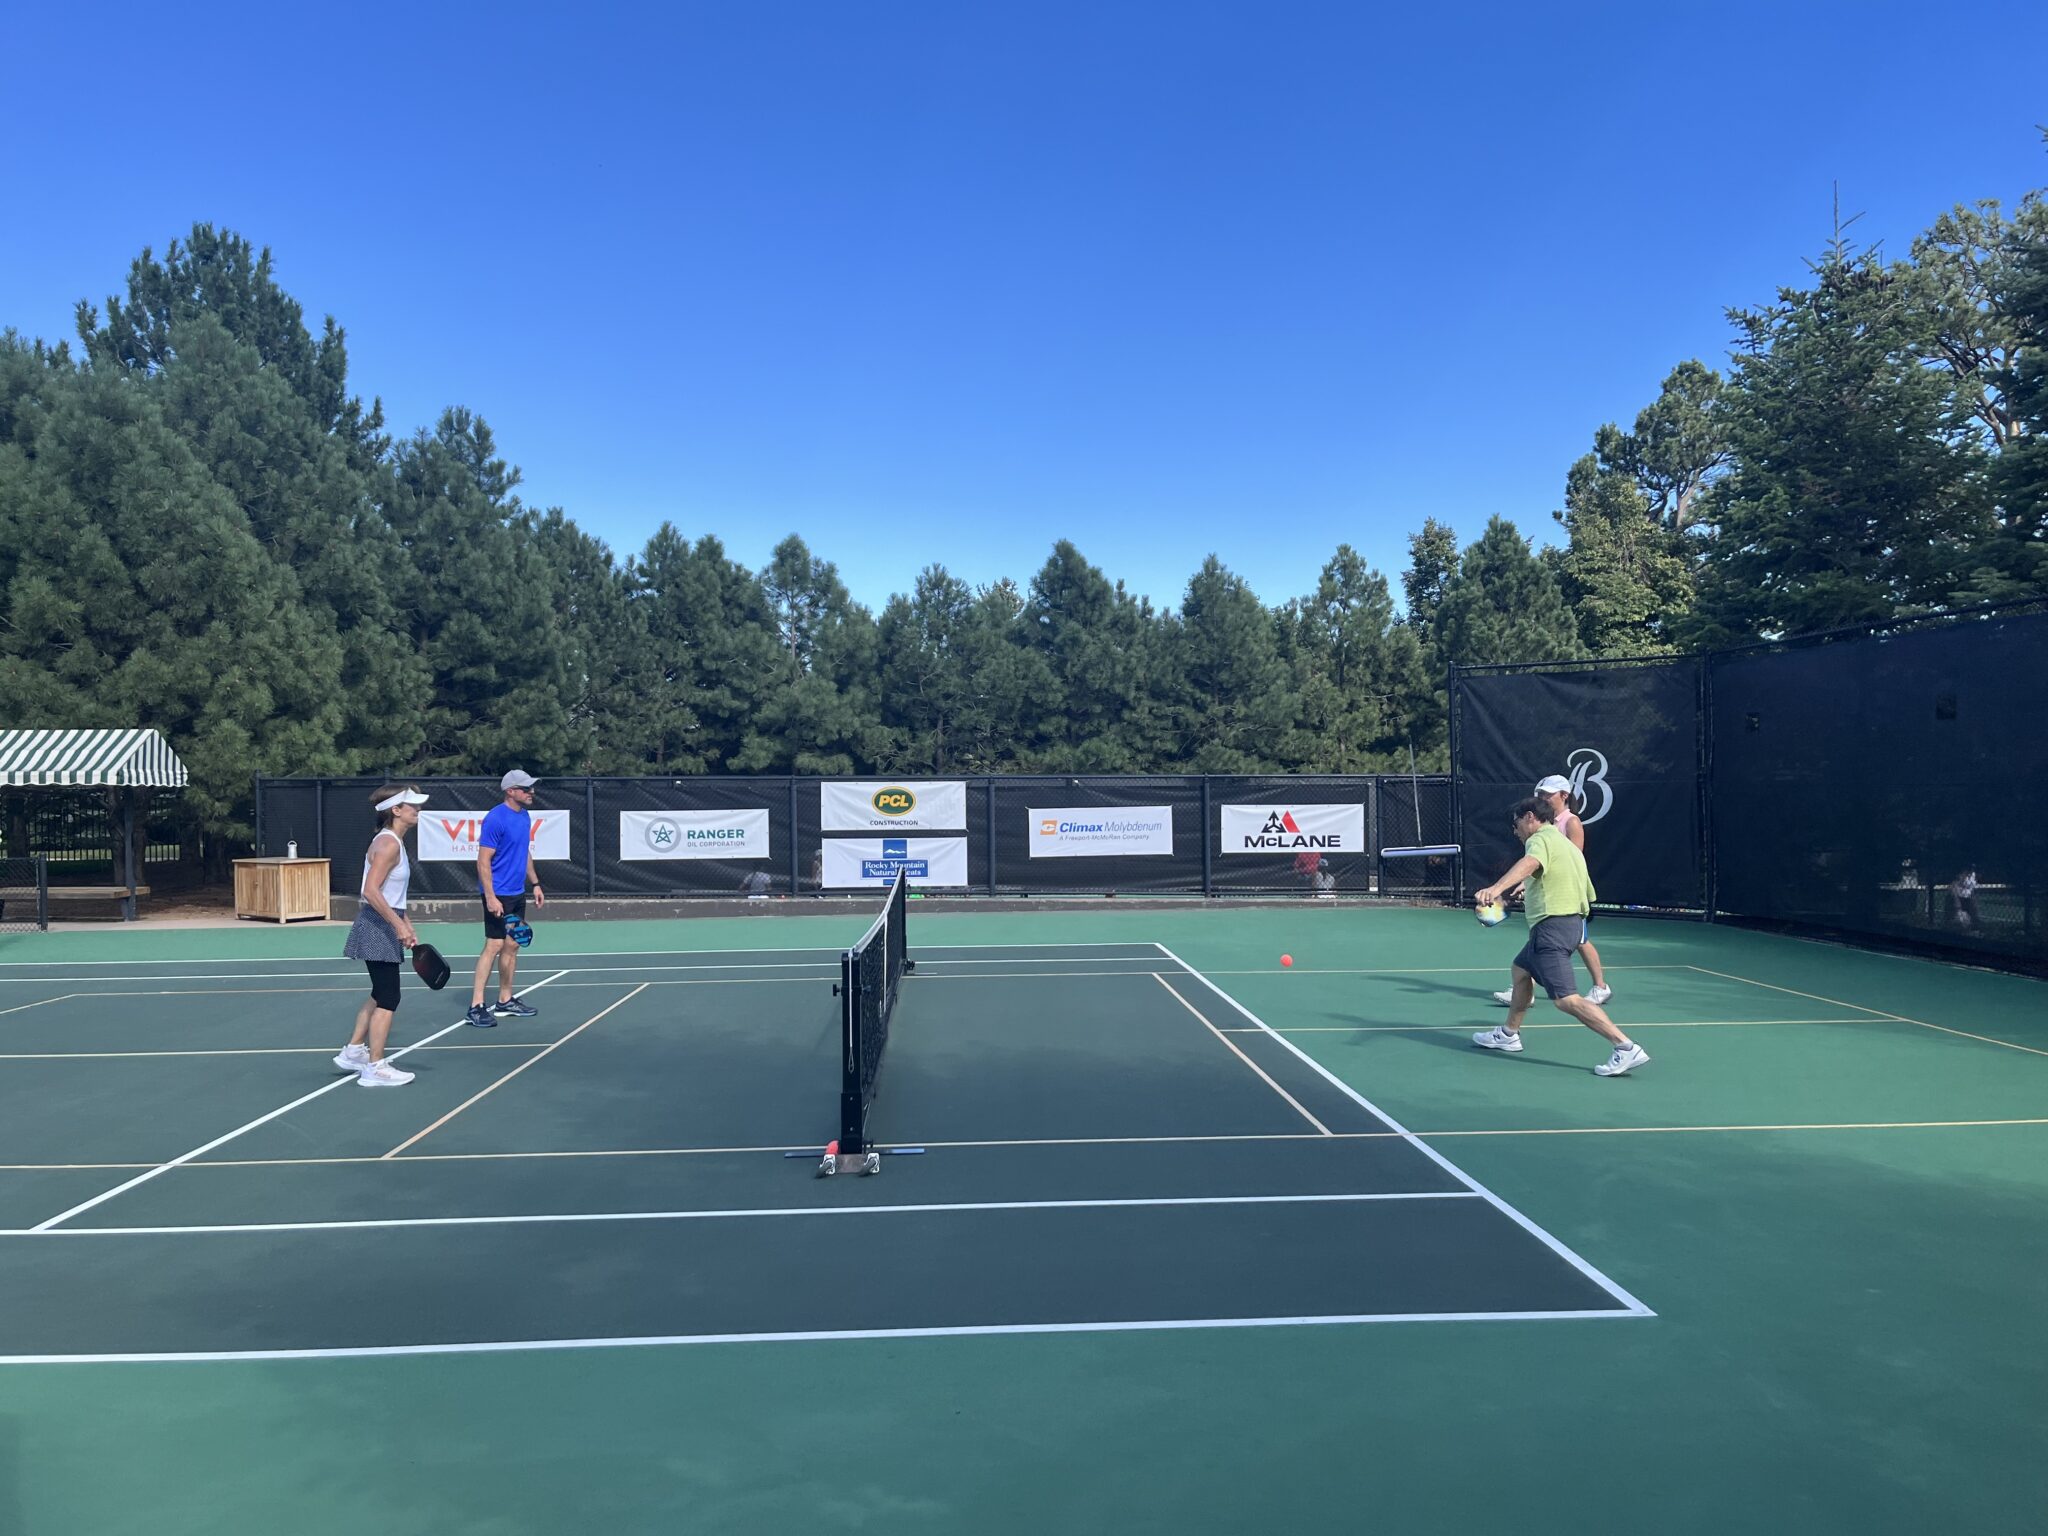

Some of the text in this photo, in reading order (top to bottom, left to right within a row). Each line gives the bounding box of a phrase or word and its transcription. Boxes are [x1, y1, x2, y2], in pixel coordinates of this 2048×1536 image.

[879, 795, 909, 807] PCL
[1059, 821, 1162, 833] Climax Molybdenum
[687, 829, 745, 840] RANGER
[699, 840, 745, 848] CORPORATION
[1244, 835, 1341, 848] McLANE
[865, 861, 925, 870] Rocky Mountain
[869, 868, 897, 876] Natural
